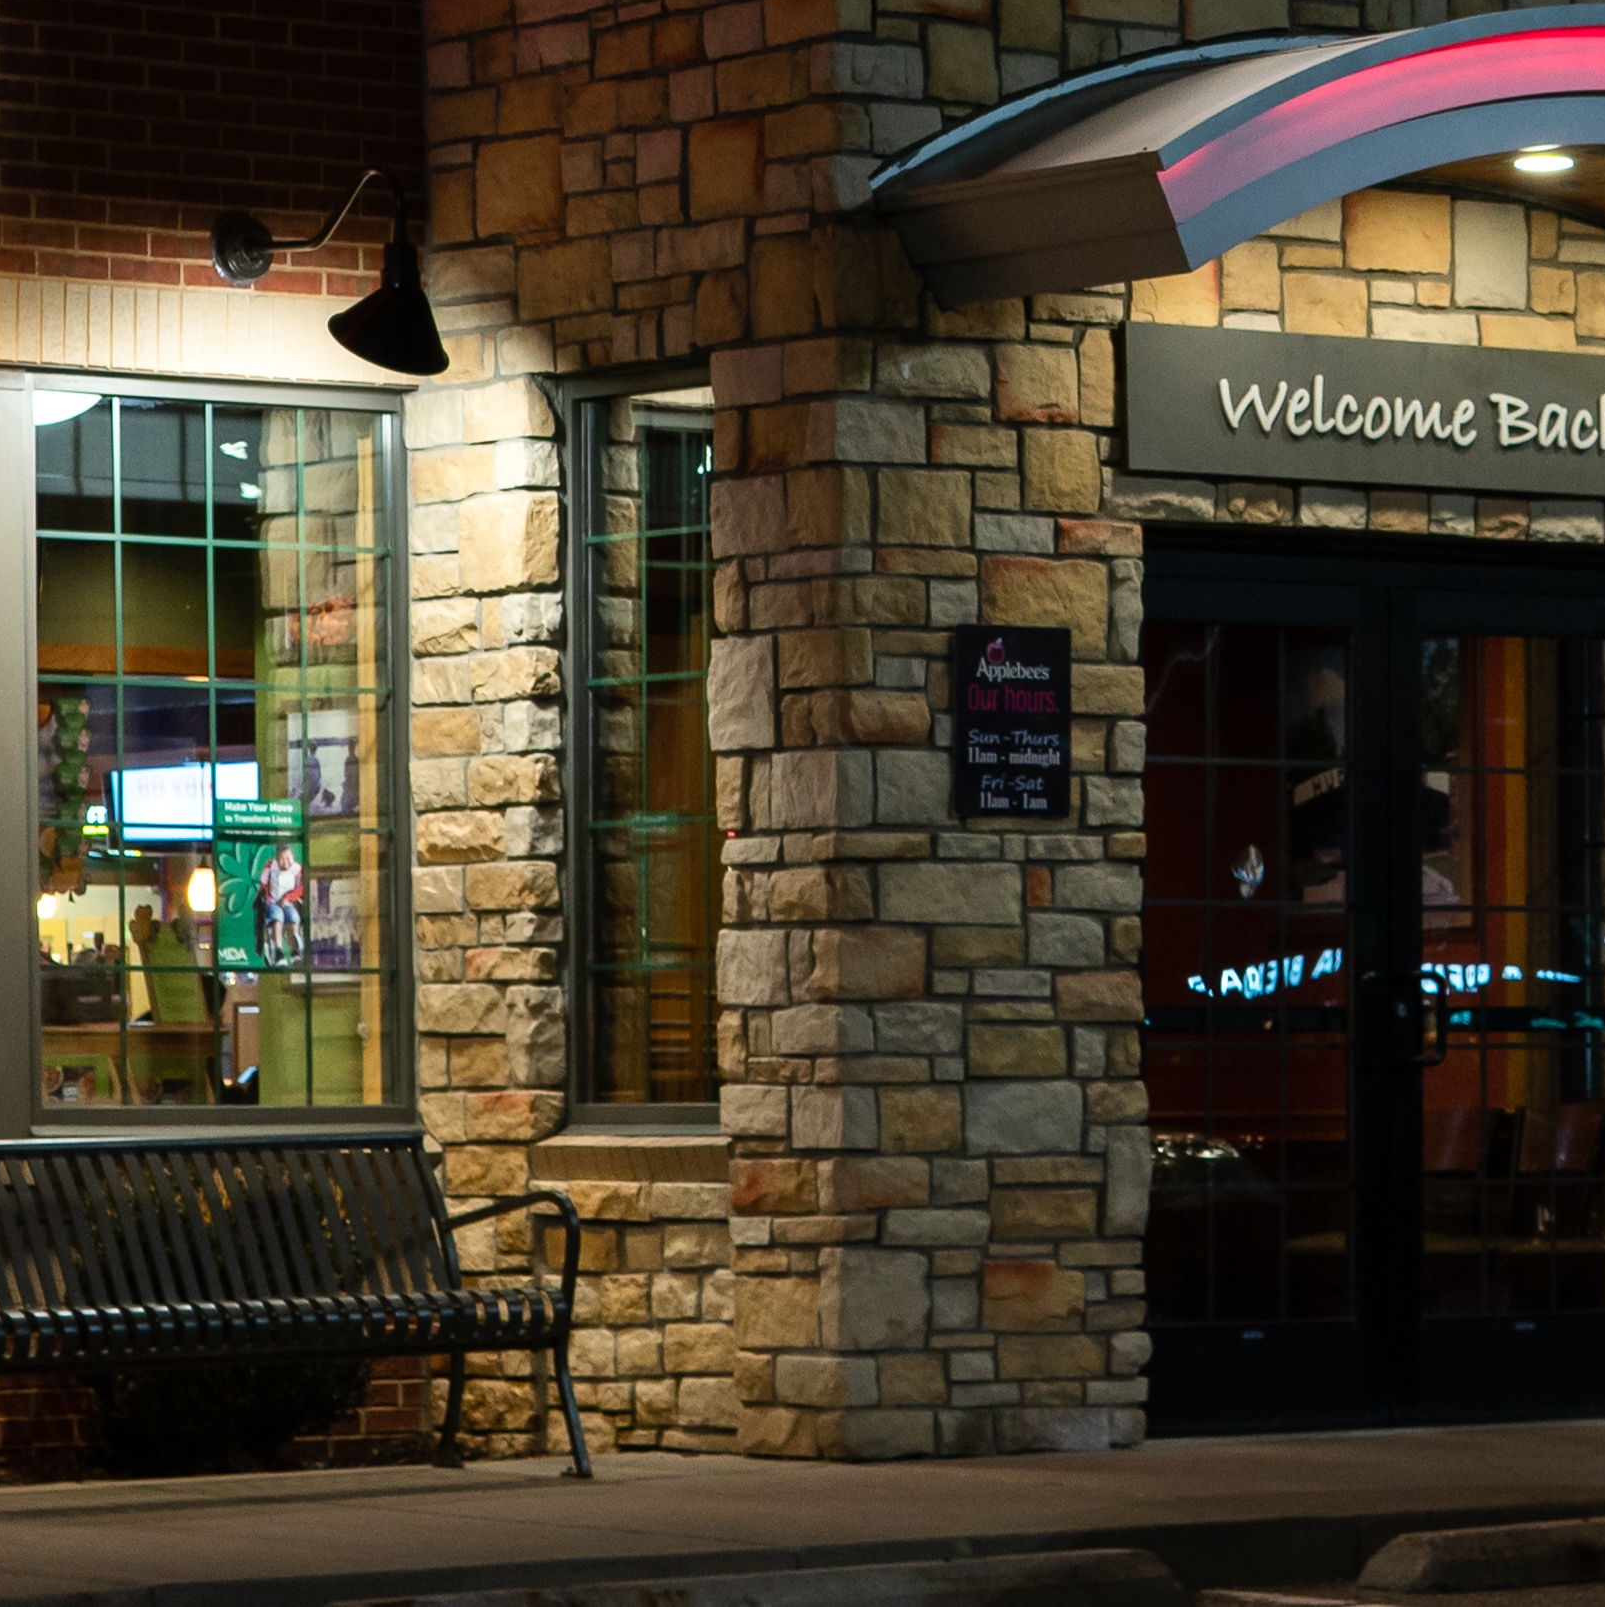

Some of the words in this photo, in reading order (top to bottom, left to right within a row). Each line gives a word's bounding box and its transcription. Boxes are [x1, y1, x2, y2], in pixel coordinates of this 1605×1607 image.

[1219, 374, 1478, 447] Welcome
[976, 655, 1051, 683] Applebee's
[968, 683, 999, 712] Our
[1004, 684, 1060, 714] hours.
[968, 746, 997, 764] 11am
[1009, 747, 1061, 768] midnight
[224, 801, 247, 812] Make
[248, 802, 268, 812] Your
[980, 791, 1009, 809] 11am
[1023, 792, 1048, 810] 1am
[233, 814, 271, 824] Transform
